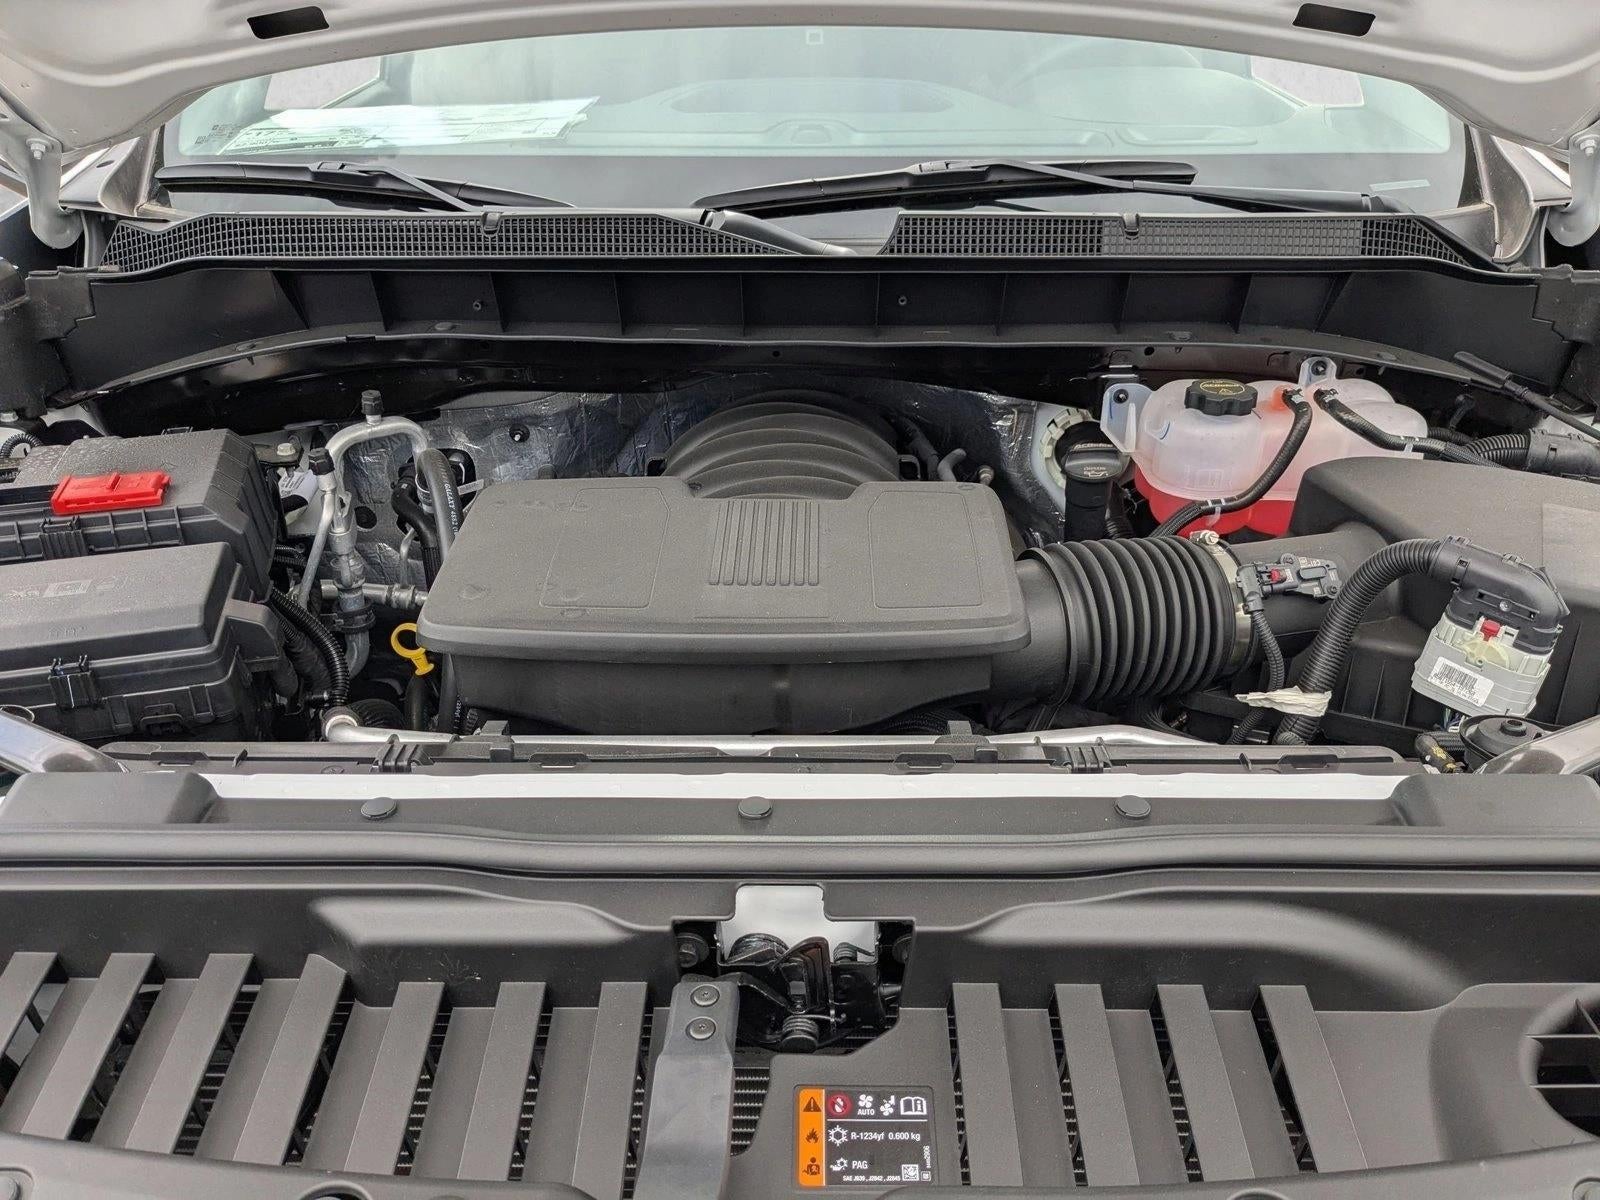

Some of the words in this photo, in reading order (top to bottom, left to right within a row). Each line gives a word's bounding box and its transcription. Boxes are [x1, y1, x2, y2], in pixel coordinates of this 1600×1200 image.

[857, 1108, 875, 1116] AUTO
[850, 1131, 885, 1142] R-1234yf
[888, 1131, 910, 1140] 0.600
[910, 1131, 921, 1142] kg
[852, 1160, 869, 1170] PAG
